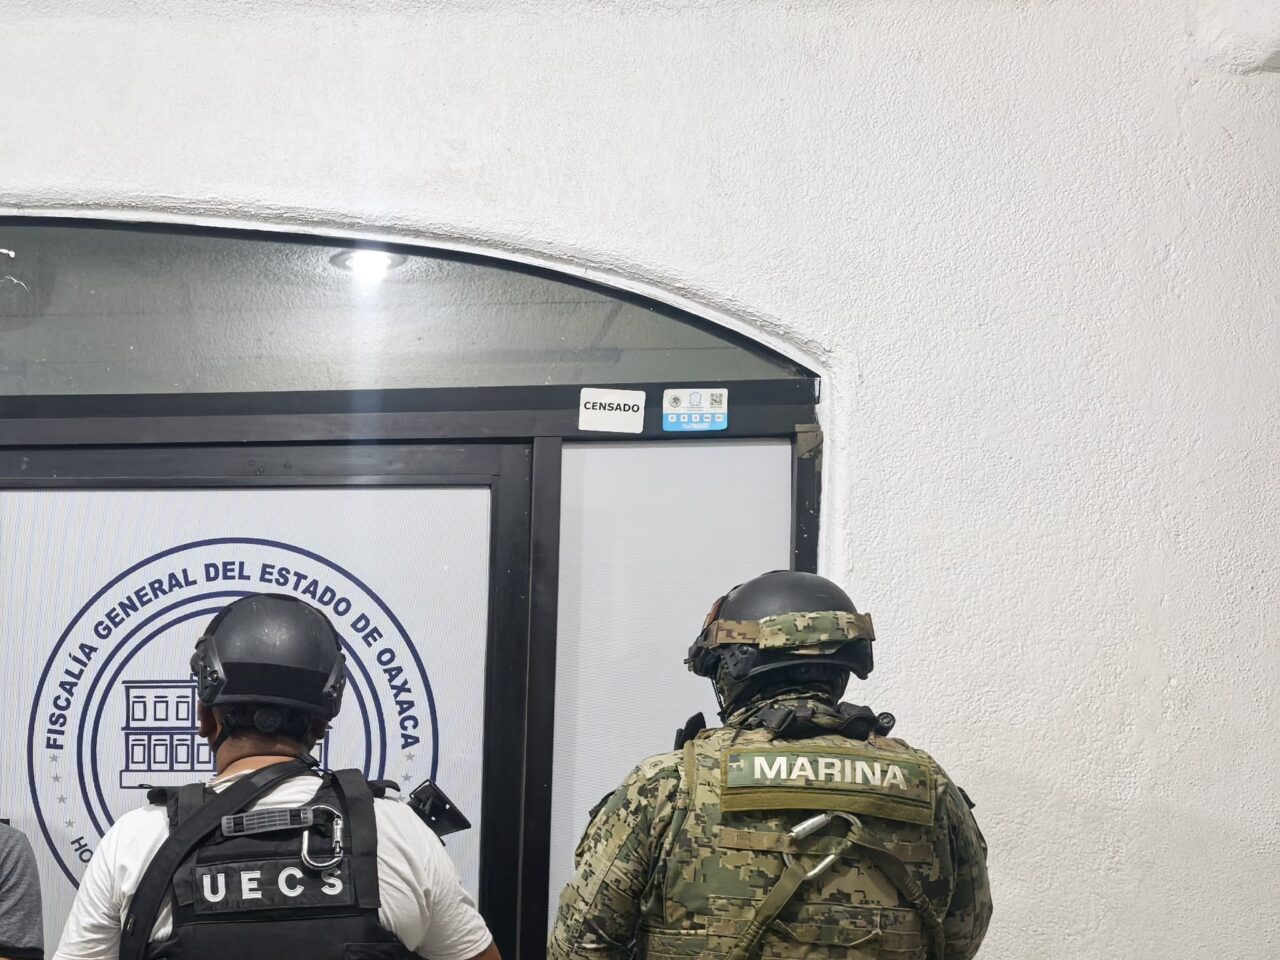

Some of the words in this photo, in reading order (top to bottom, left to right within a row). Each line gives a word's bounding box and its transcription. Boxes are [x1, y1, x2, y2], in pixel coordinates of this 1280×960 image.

[583, 401, 640, 413] CENSADO
[45, 642, 99, 750] FISCALÍA
[93, 568, 198, 640] GENERAL
[204, 561, 251, 582] DEL
[259, 563, 352, 617] ESTADO
[350, 612, 384, 648] DE
[376, 647, 420, 750] OAXACA
[753, 755, 908, 790] MARINA
[202, 866, 344, 903] UECS
